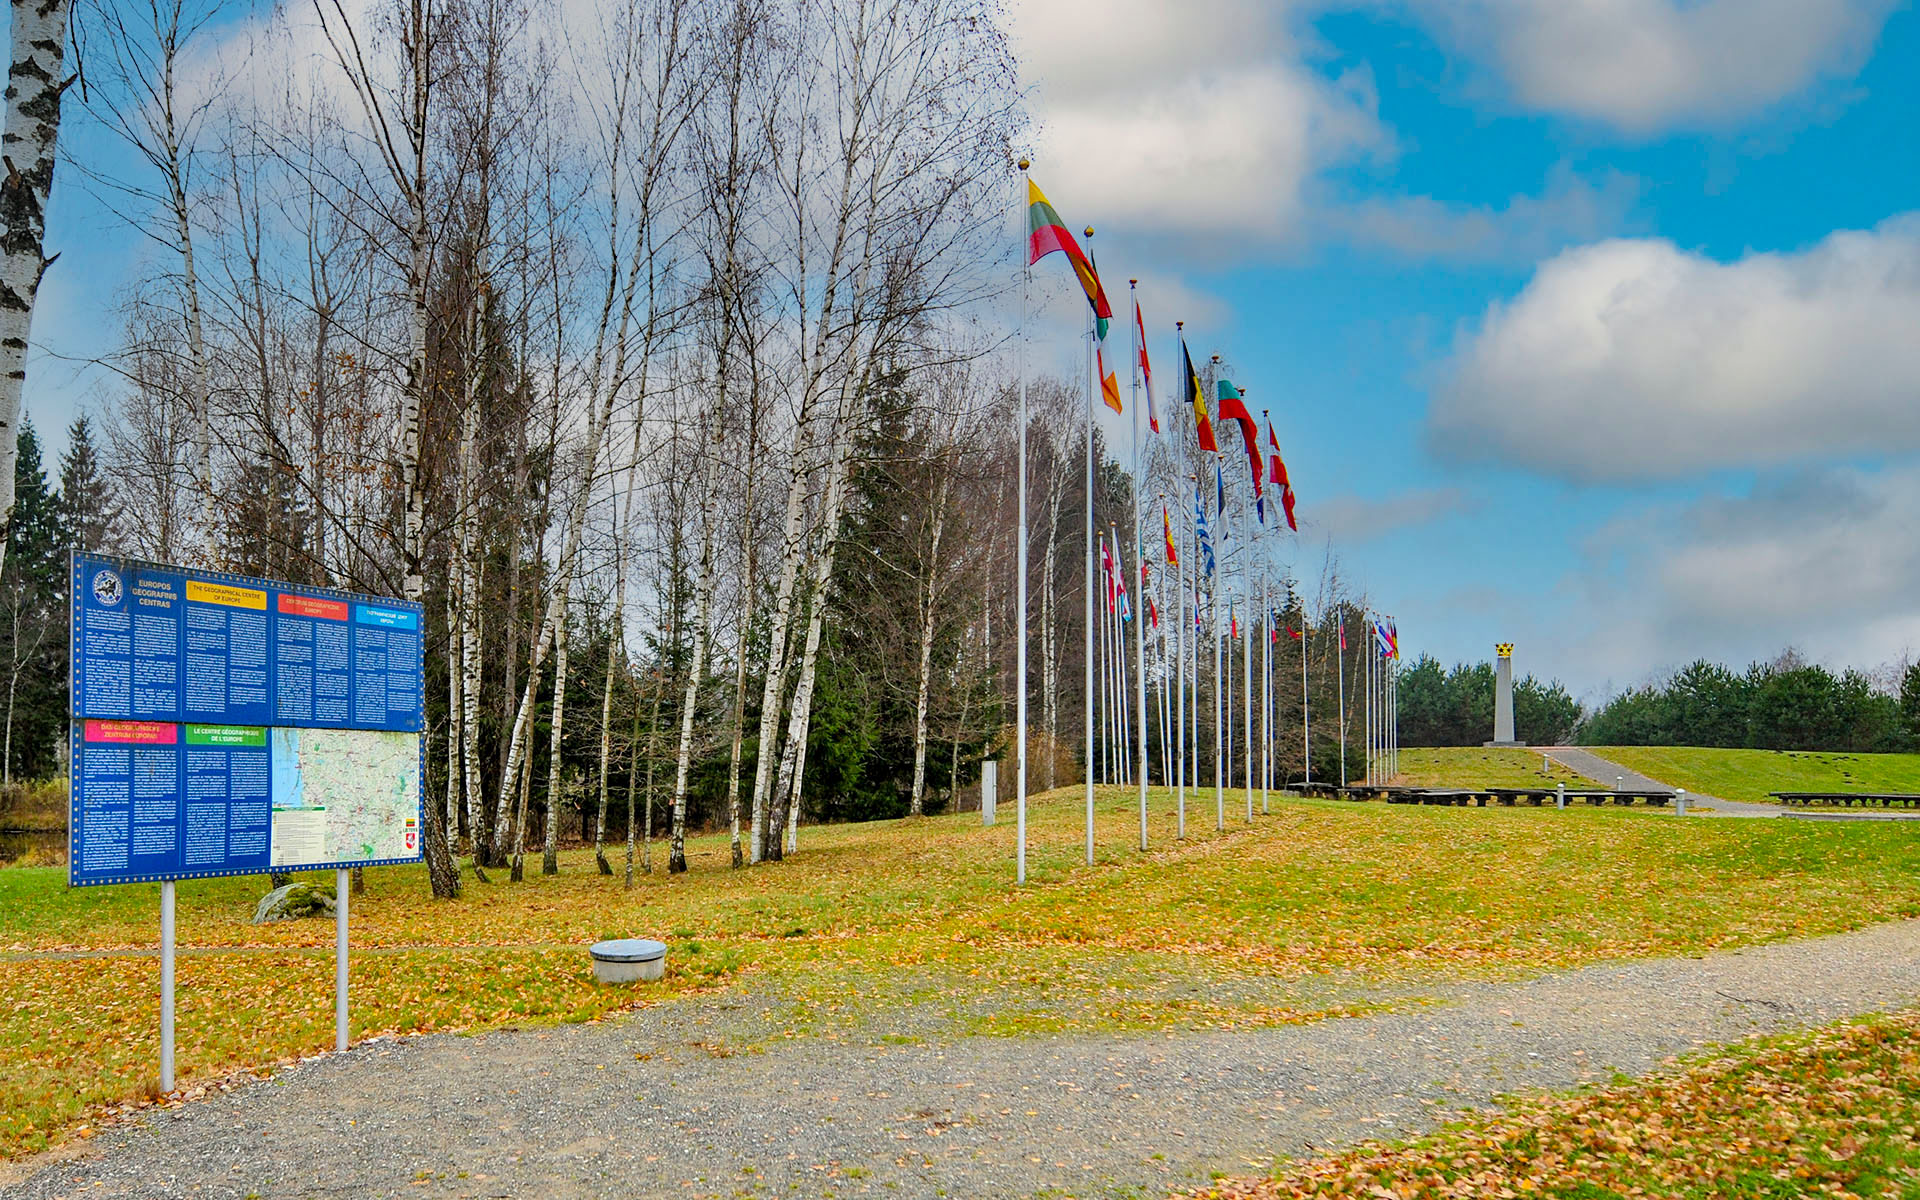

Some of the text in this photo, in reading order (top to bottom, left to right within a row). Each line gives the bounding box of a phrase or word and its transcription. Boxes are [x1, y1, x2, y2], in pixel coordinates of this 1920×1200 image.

[138, 579, 171, 590] EUROPOS
[204, 586, 241, 597] GEOGRAPHICAL
[138, 598, 171, 608] CENTRAS
[222, 595, 241, 603] EUROPE
